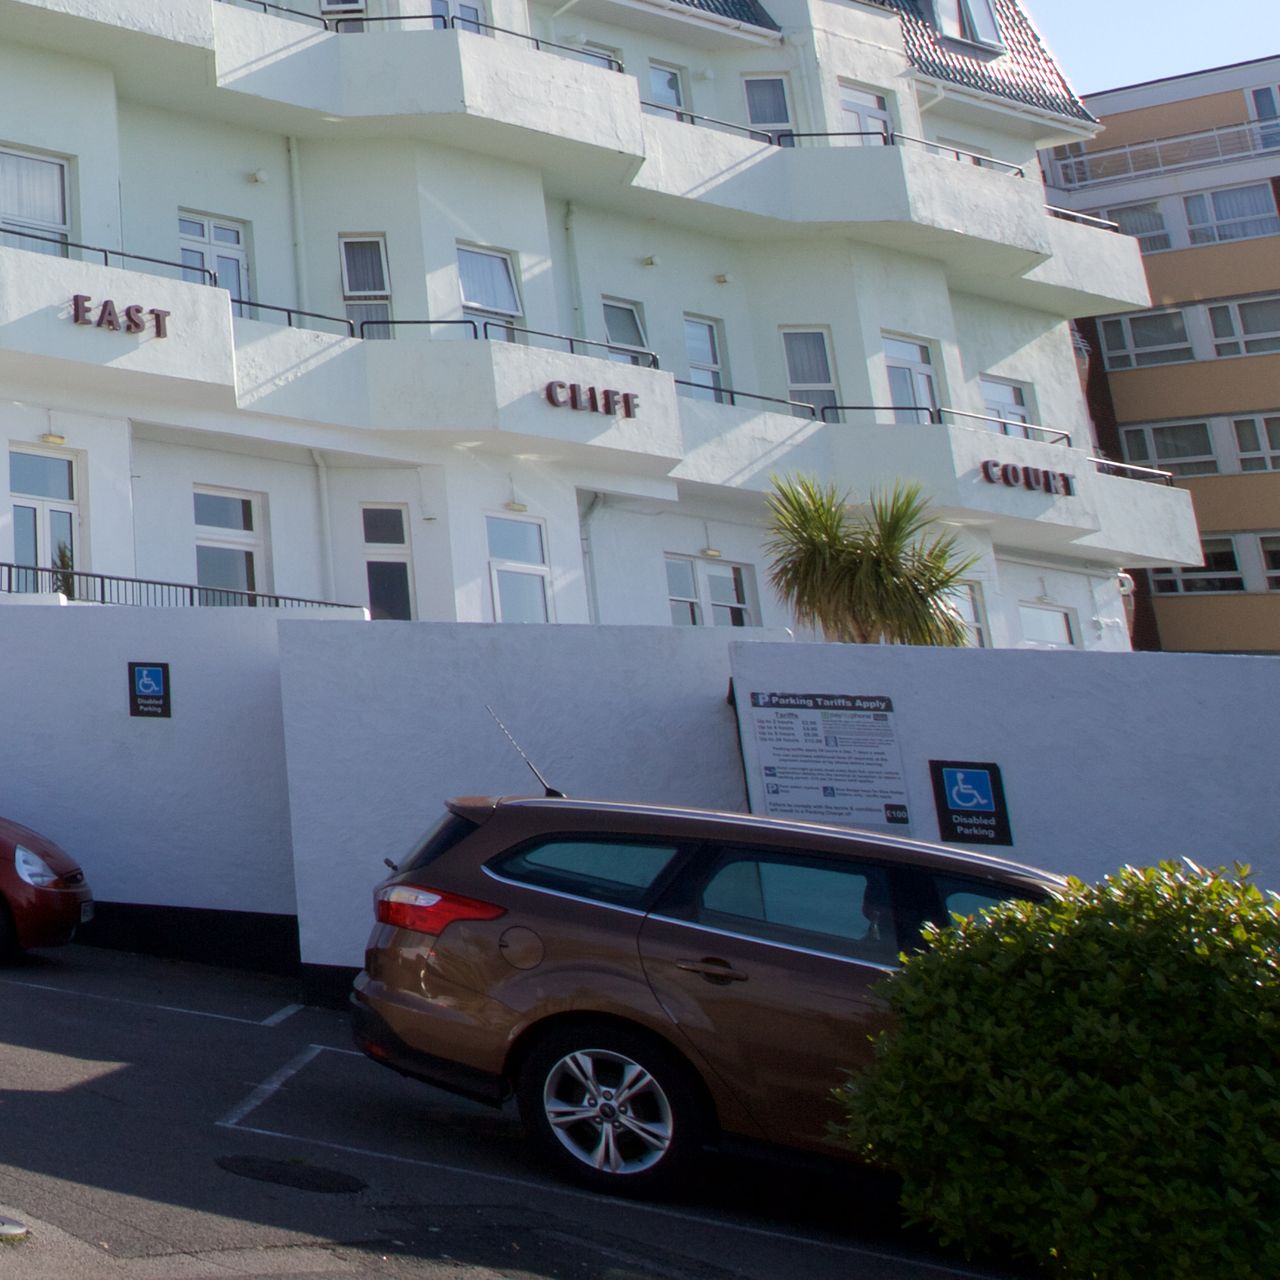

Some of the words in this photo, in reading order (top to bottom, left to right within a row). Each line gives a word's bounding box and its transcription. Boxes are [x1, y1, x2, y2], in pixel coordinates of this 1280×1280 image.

[72, 294, 171, 339] EAST
[545, 380, 640, 419] CLIFF
[981, 459, 1076, 496] COURT
[771, 696, 813, 707] Parking
[816, 698, 852, 707] Tariffs
[855, 699, 886, 709] Apply
[952, 815, 996, 825] Disabled
[957, 826, 994, 838] Parking
